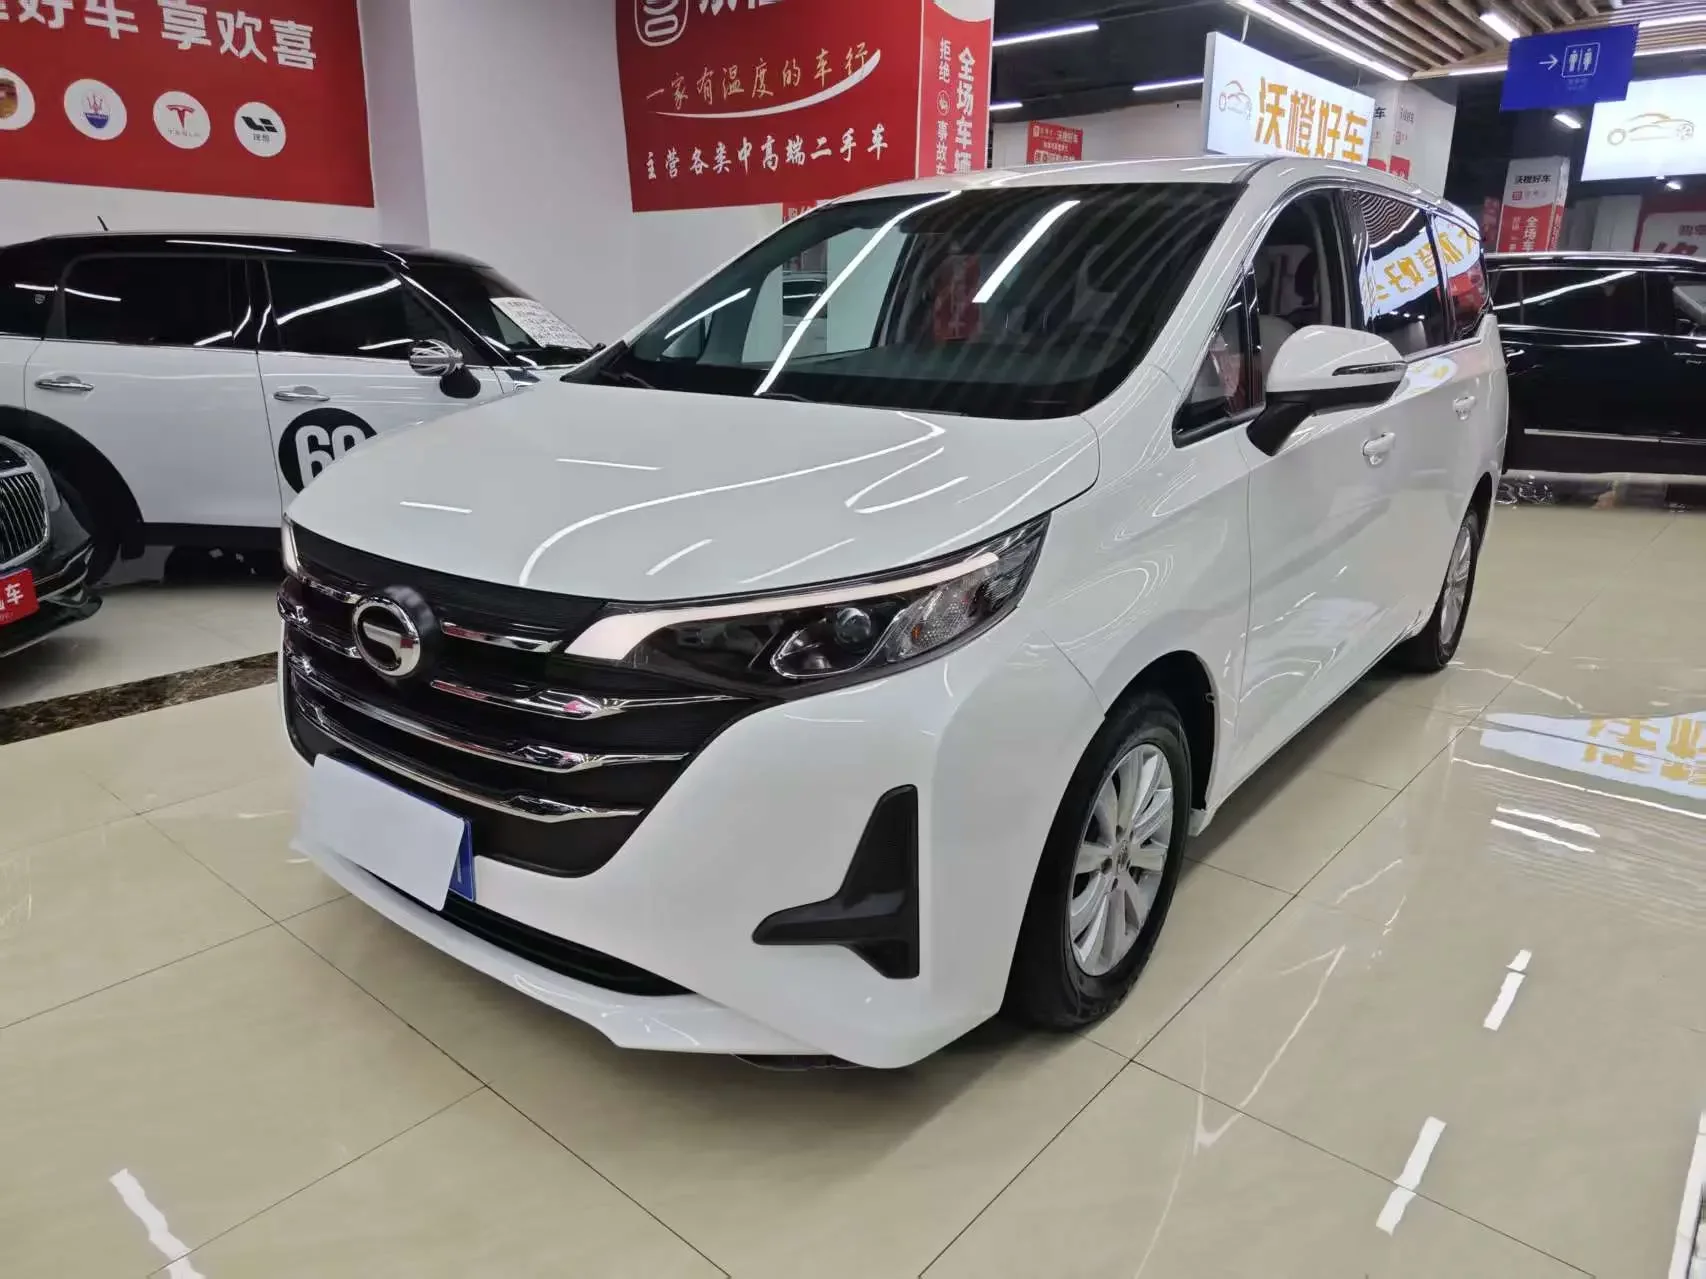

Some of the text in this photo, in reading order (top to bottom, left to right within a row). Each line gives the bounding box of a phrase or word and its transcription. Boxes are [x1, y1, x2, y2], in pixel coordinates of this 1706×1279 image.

[160, 0, 317, 70] 享欢喜
[646, 42, 868, 110] 一家有温度的车行
[1255, 76, 1368, 163] 沃橙好车
